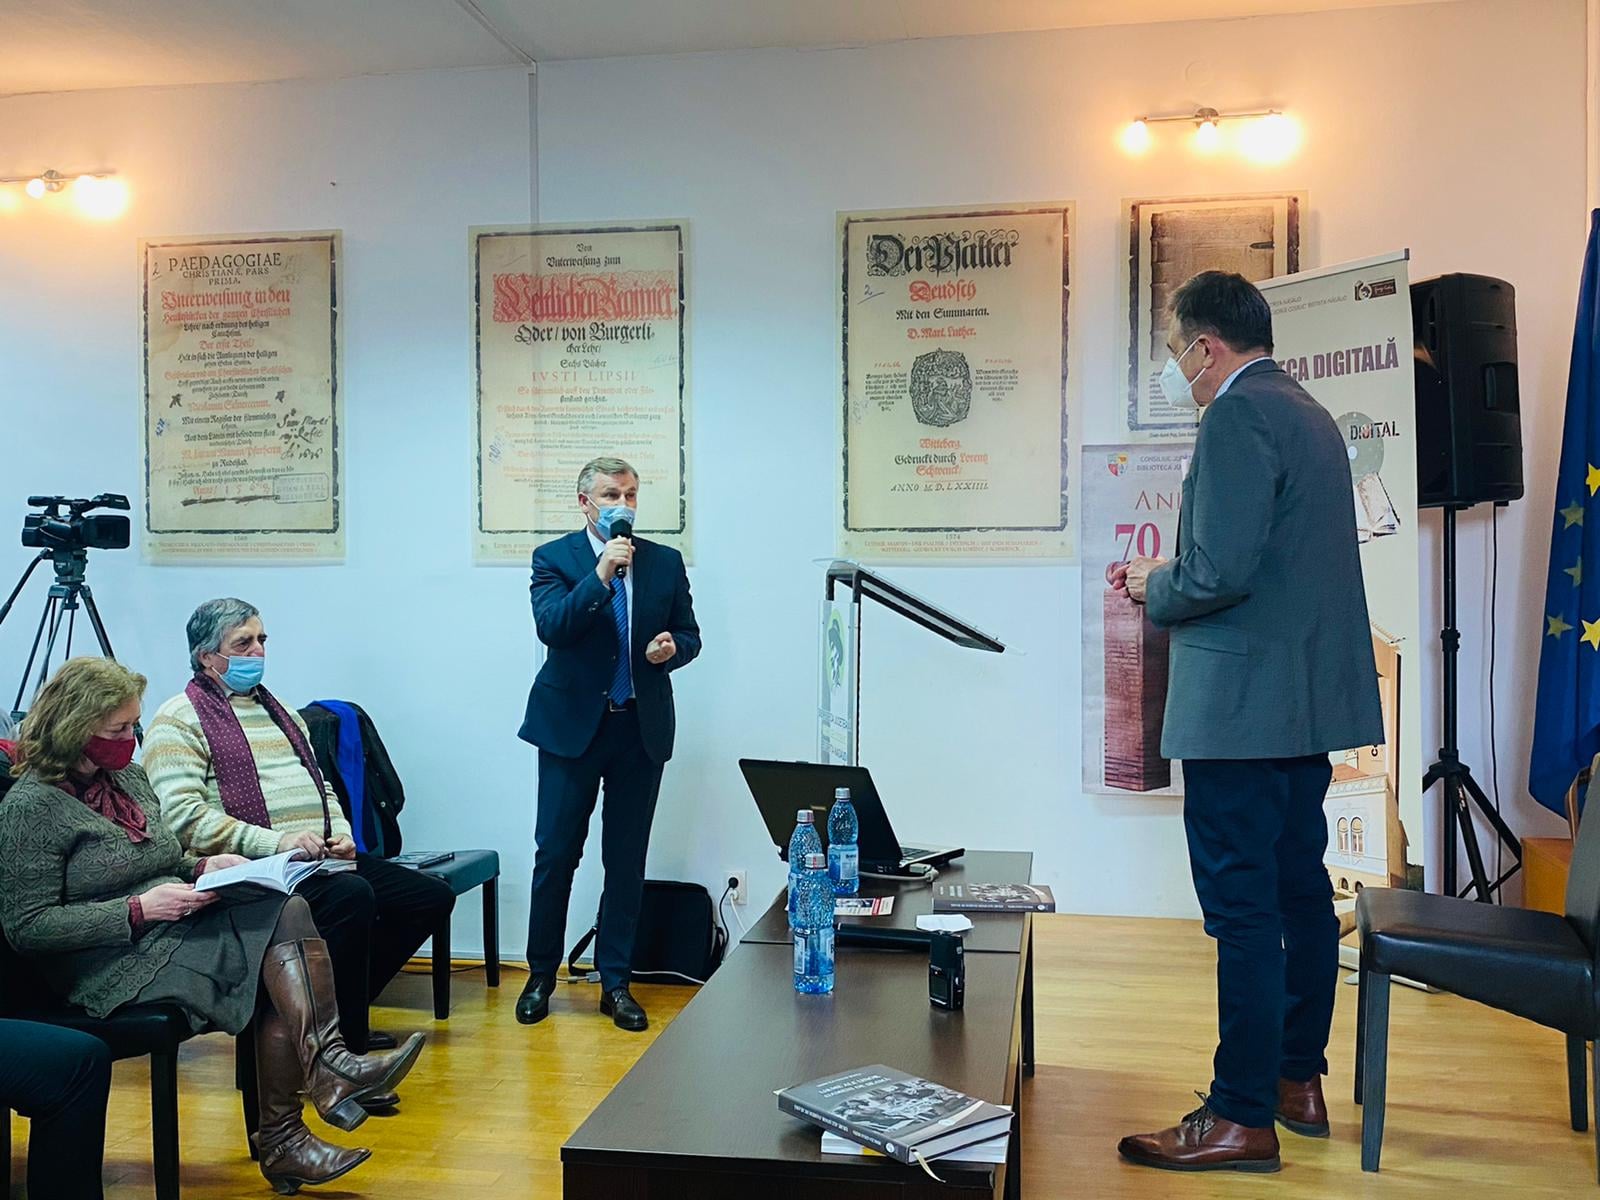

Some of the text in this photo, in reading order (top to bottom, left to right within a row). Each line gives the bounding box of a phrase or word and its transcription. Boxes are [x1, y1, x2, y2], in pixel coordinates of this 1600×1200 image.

[169, 253, 282, 271] PAEDAGOGIAE
[246, 267, 270, 276] PARS
[562, 327, 586, 342] von
[1313, 336, 1399, 380] DIGITALĂ
[1135, 490, 1180, 511] ANI
[1115, 522, 1161, 561] 70
